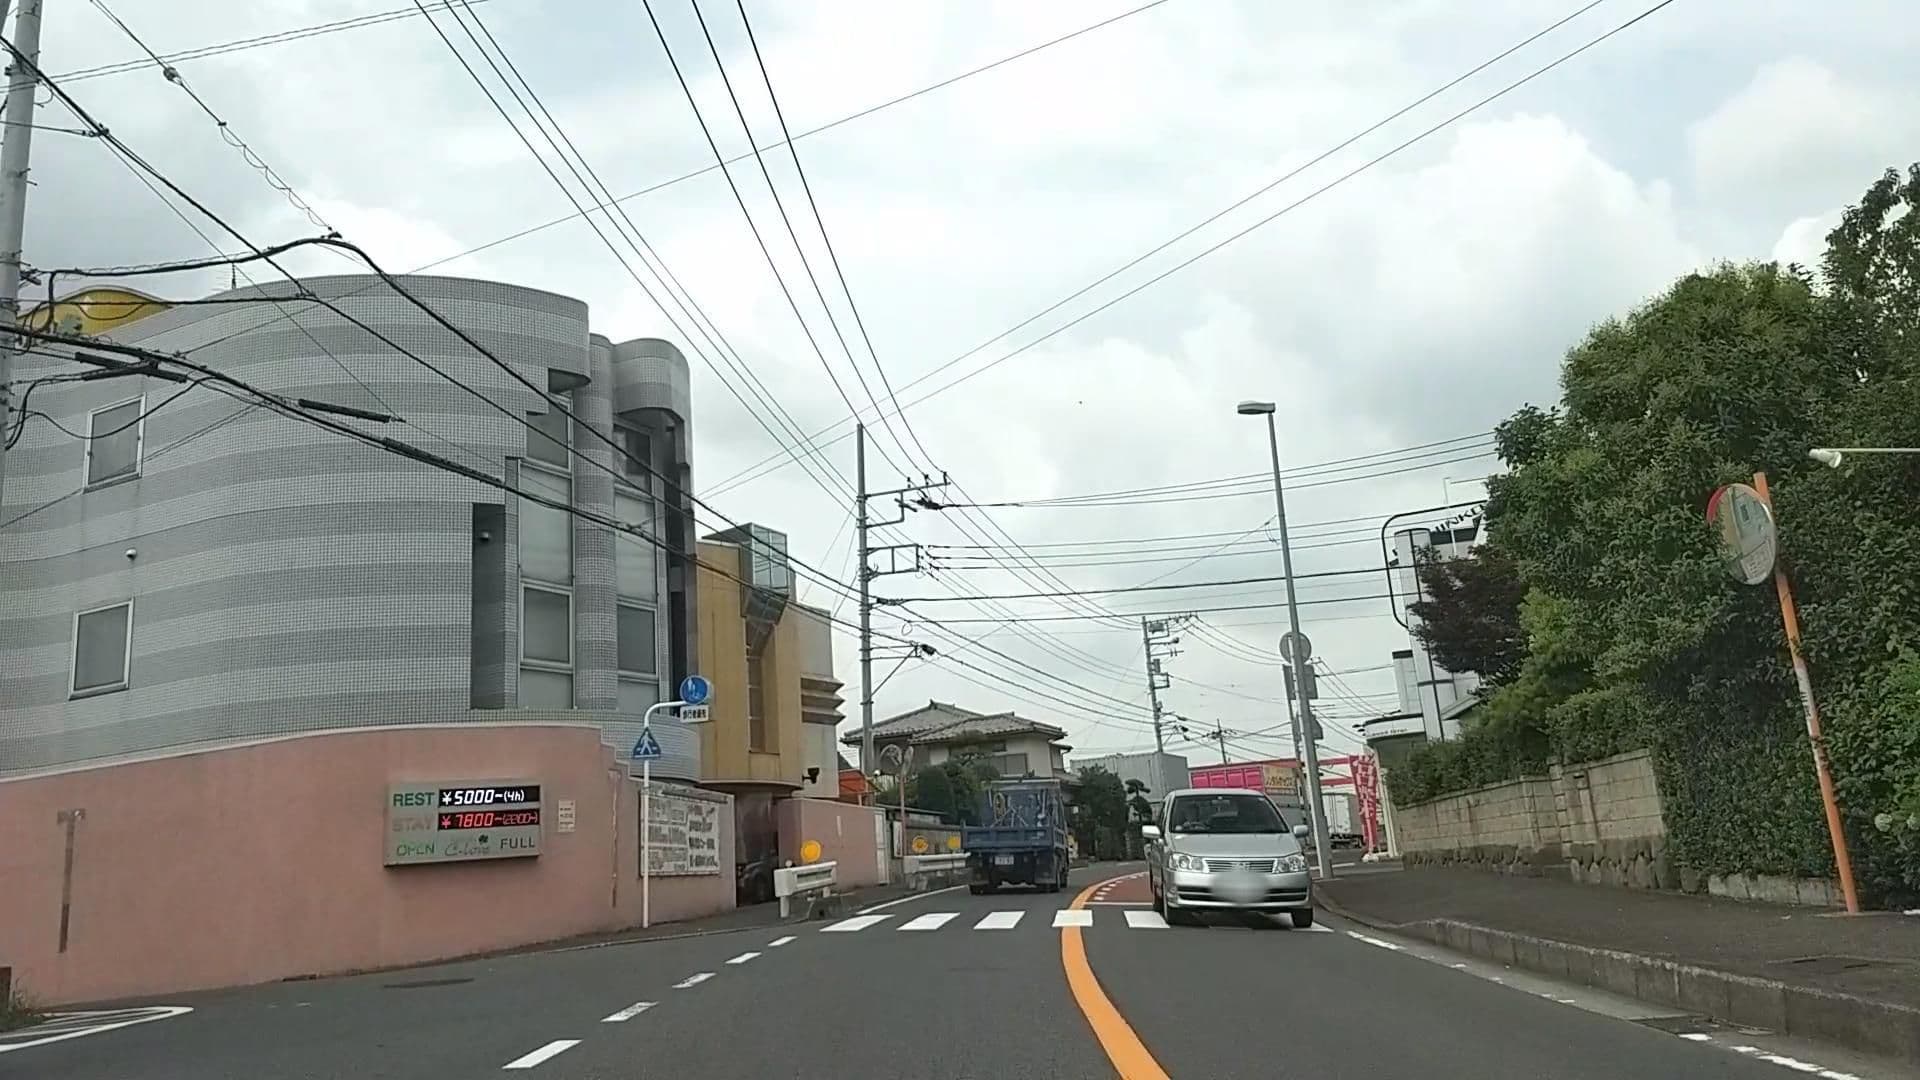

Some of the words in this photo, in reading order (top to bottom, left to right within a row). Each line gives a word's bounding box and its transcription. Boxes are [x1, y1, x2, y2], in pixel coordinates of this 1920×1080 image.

[393, 793, 434, 807] REST
[397, 840, 435, 857] OPEN
[500, 836, 535, 849] FULL
